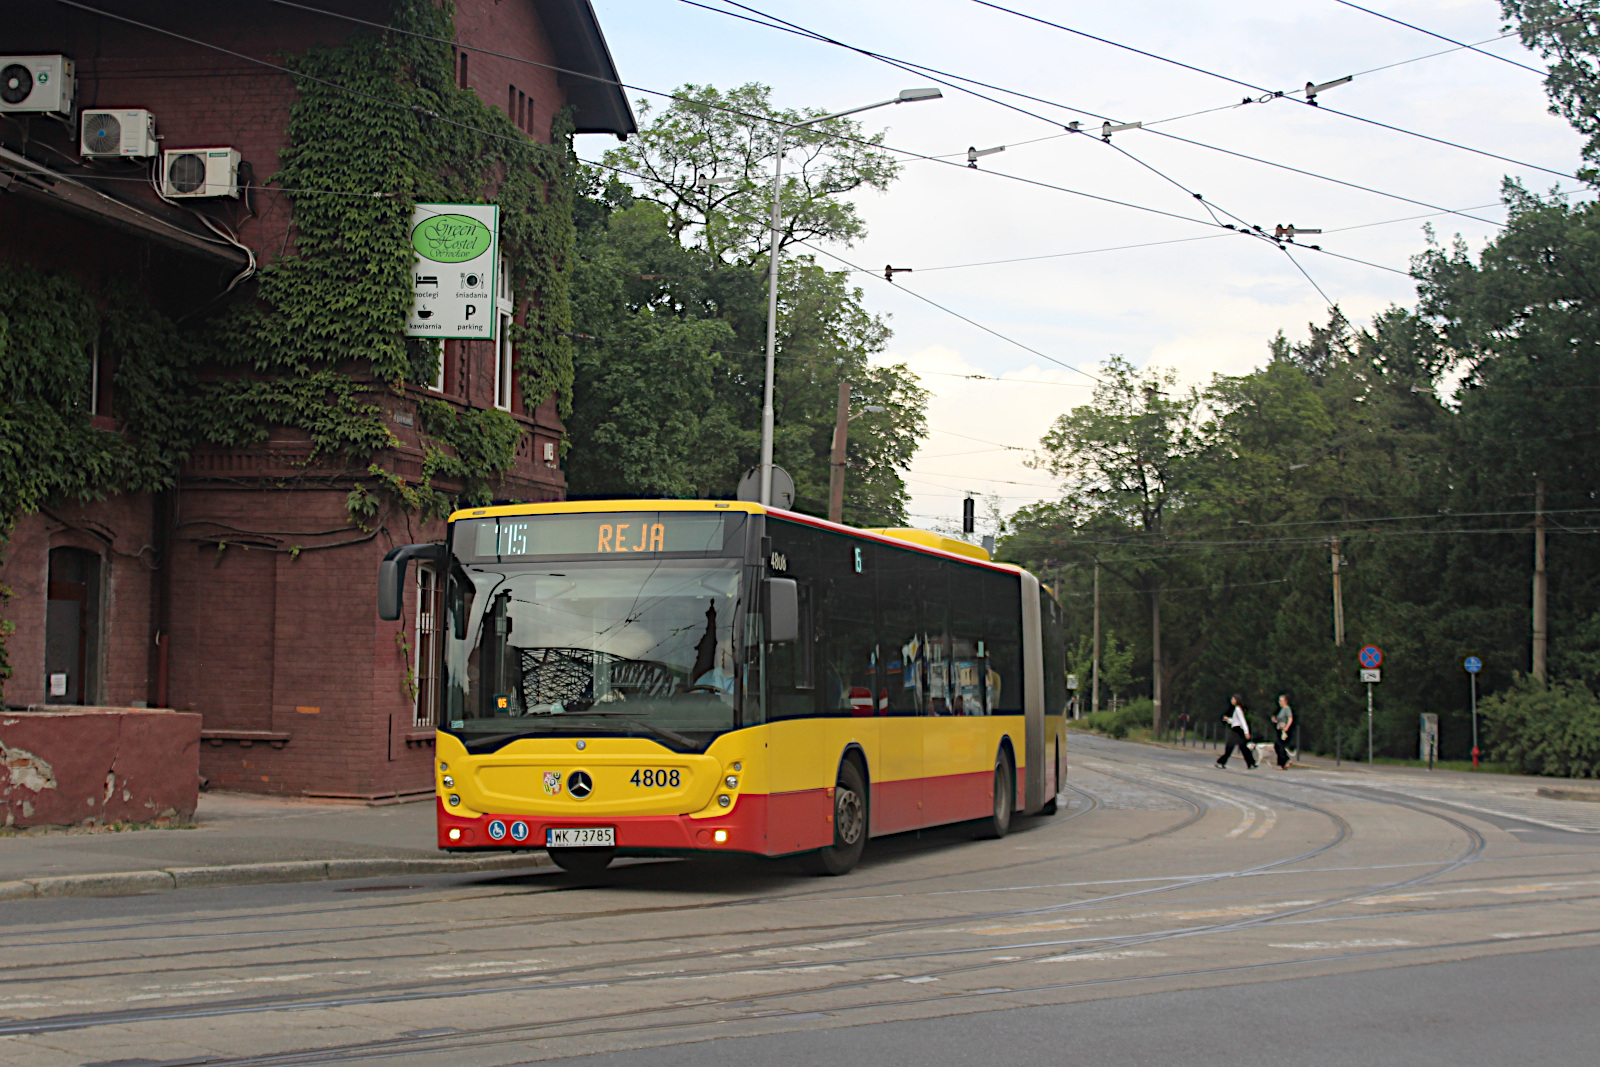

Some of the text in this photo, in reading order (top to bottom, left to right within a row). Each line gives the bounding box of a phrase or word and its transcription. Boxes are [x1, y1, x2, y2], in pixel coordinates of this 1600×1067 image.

[425, 219, 477, 240] Green
[429, 236, 478, 250] Hostel
[456, 291, 488, 299] śniadania
[457, 323, 483, 331] parking
[597, 523, 665, 552] REJA
[497, 697, 508, 709] 05
[630, 769, 681, 788] 4808
[554, 829, 612, 842] WK 73785
